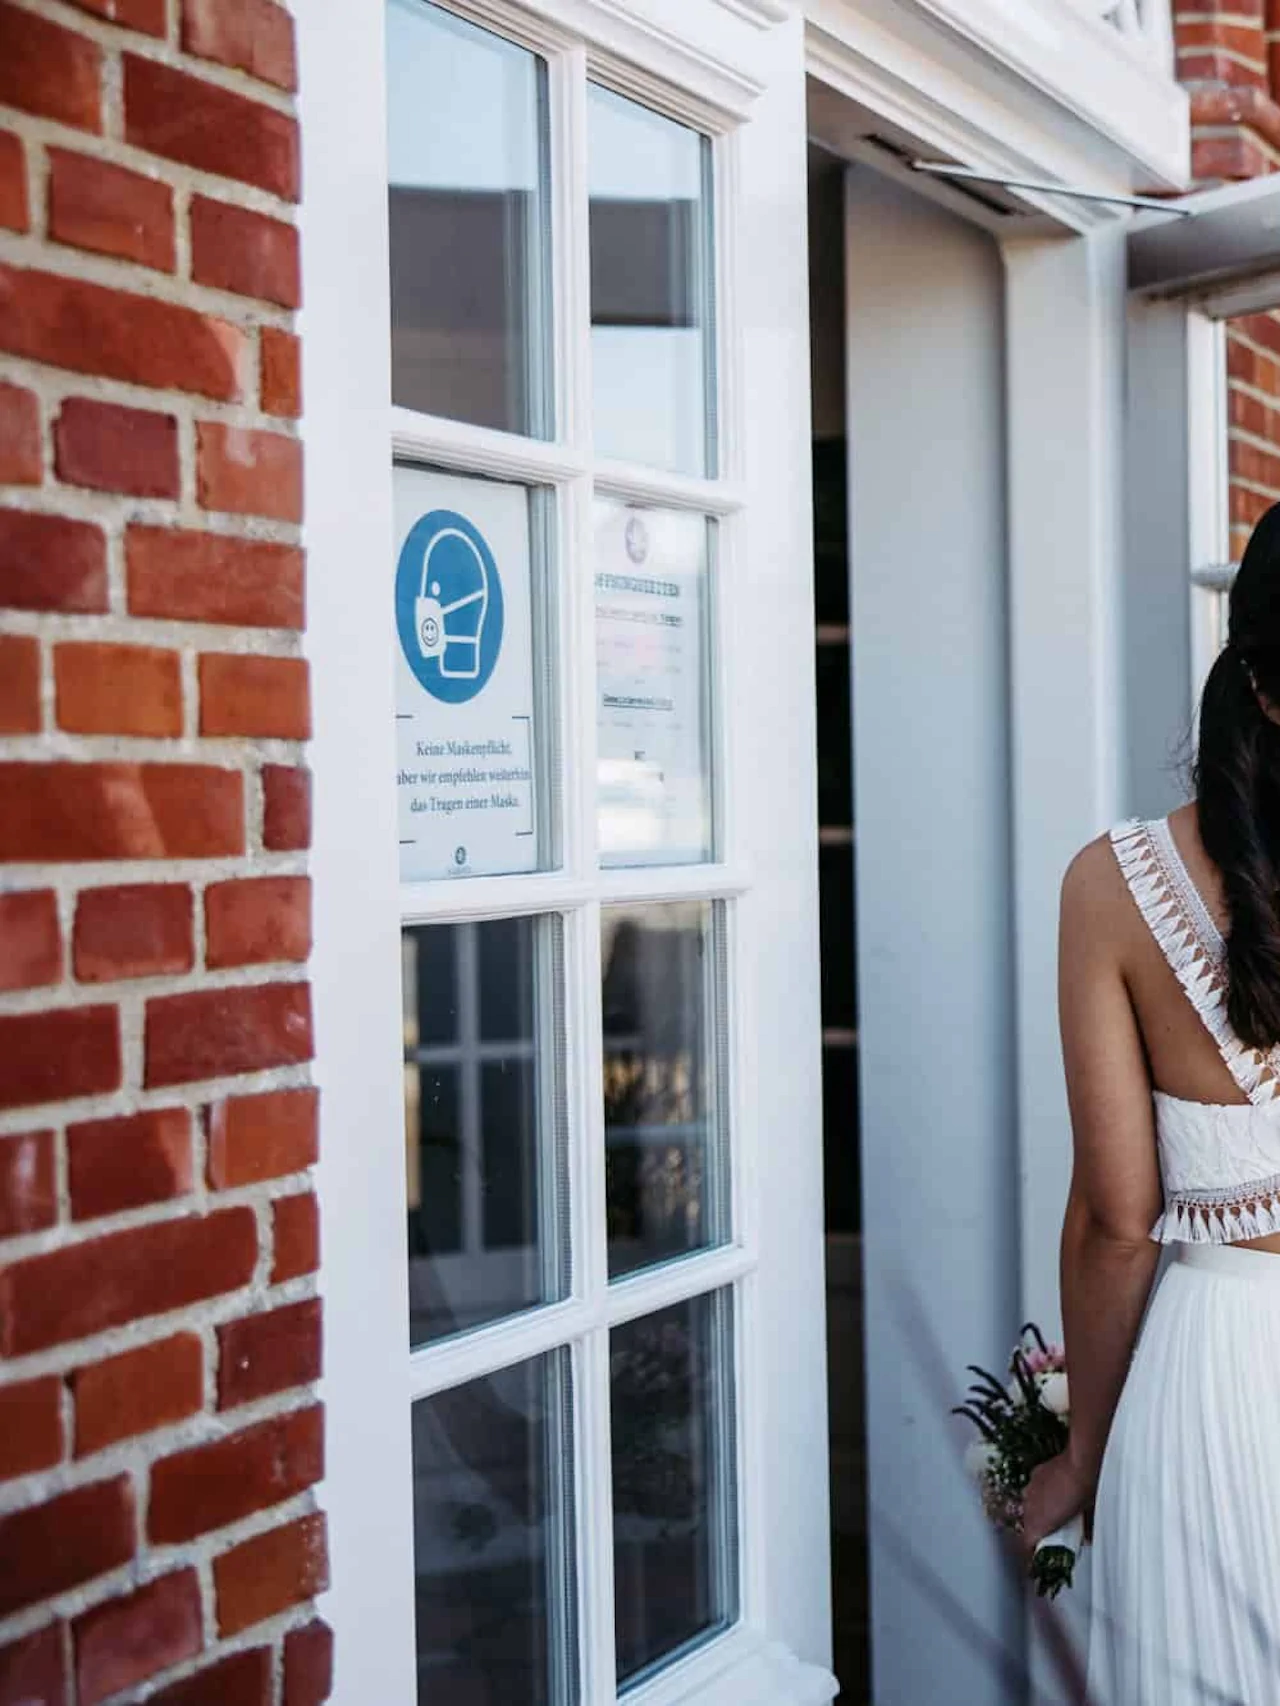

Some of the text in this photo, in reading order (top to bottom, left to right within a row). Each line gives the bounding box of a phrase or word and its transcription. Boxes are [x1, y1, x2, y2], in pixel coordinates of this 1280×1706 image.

[416, 741, 445, 757] Keine
[420, 769, 437, 783] wir
[438, 767, 486, 786] empfehlen
[410, 798, 427, 812] das
[430, 796, 463, 815] Tragen
[465, 796, 489, 809] einer
